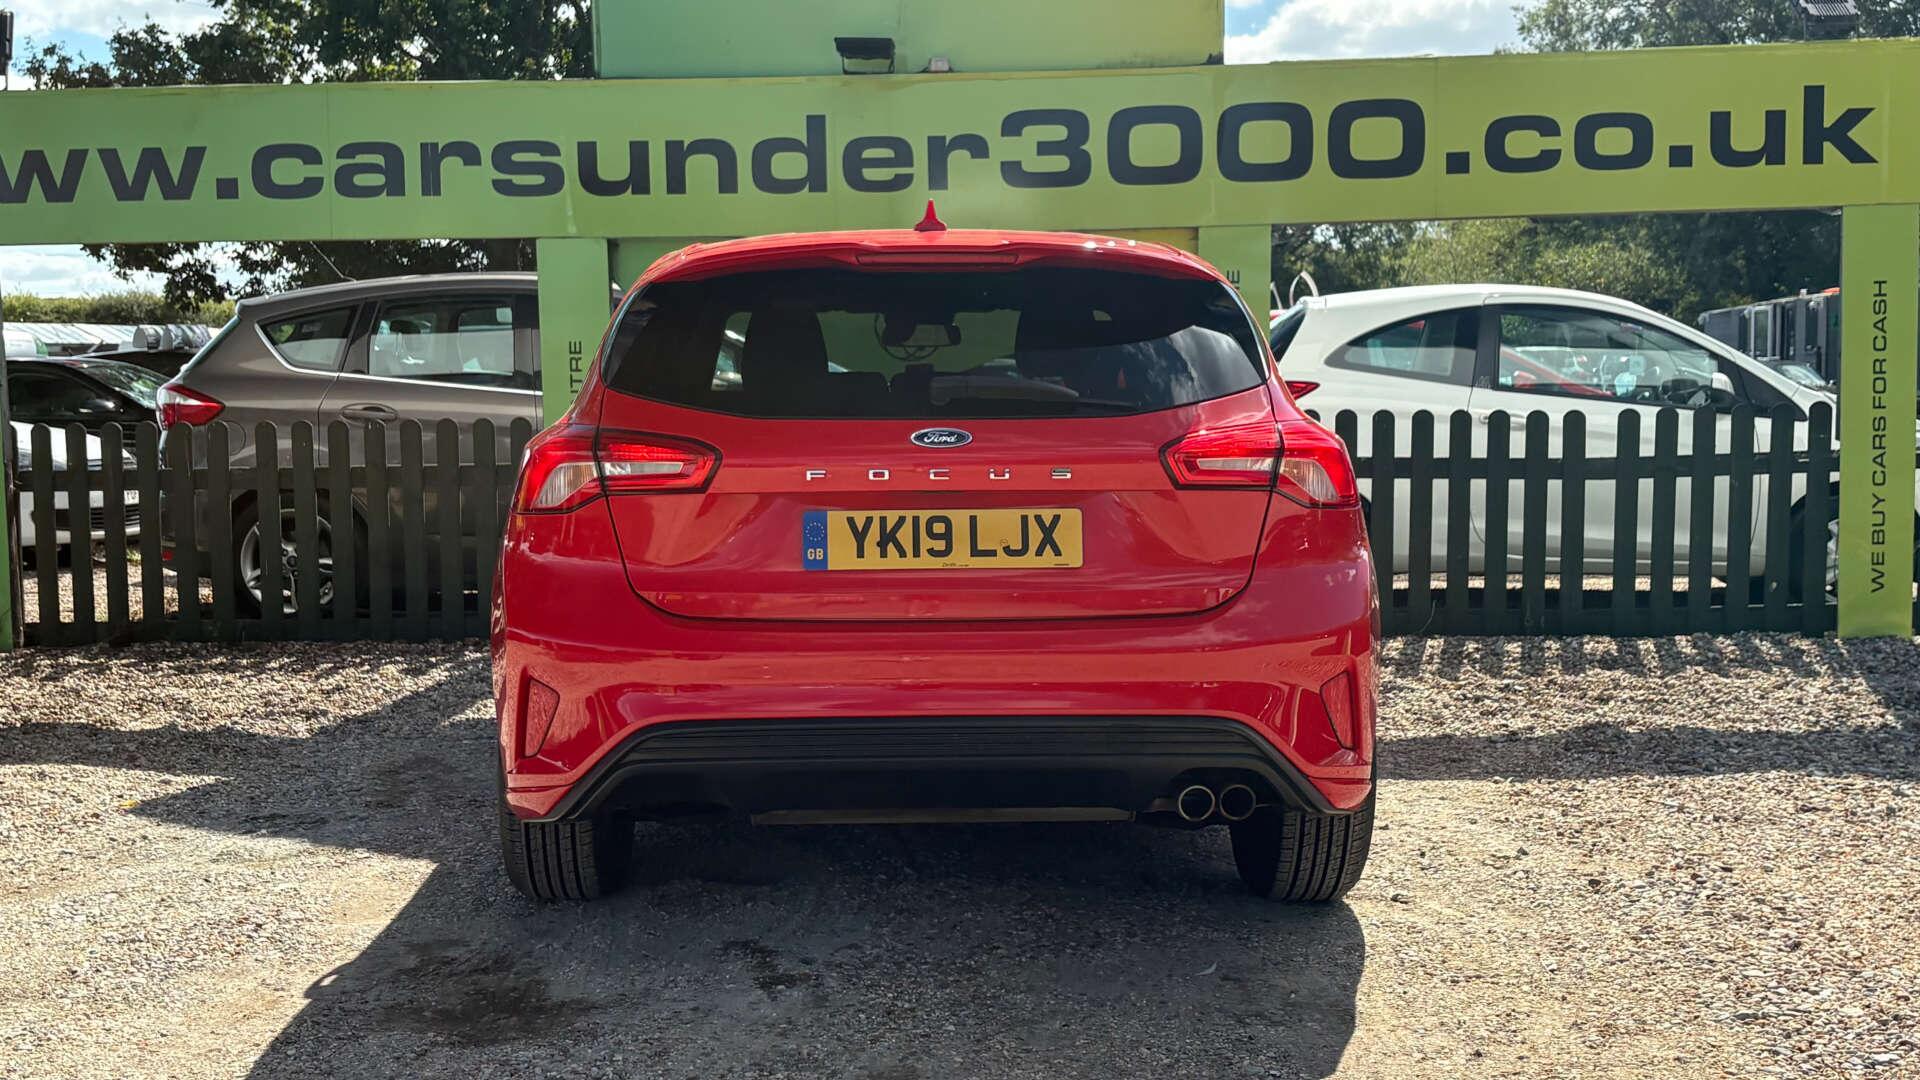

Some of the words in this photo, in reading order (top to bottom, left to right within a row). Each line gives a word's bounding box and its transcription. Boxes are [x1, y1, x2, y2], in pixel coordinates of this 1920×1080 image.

[1873, 280, 1888, 352] CASH
[1872, 358, 1887, 410] FOR
[923, 431, 958, 443] Ford
[1872, 416, 1887, 486] CARS
[806, 468, 1072, 481] FOCUS
[846, 515, 953, 559] YK19
[969, 514, 1063, 558] LJX
[1871, 492, 1886, 546] BUY
[807, 549, 824, 560] GB
[1870, 551, 1885, 592] WE
